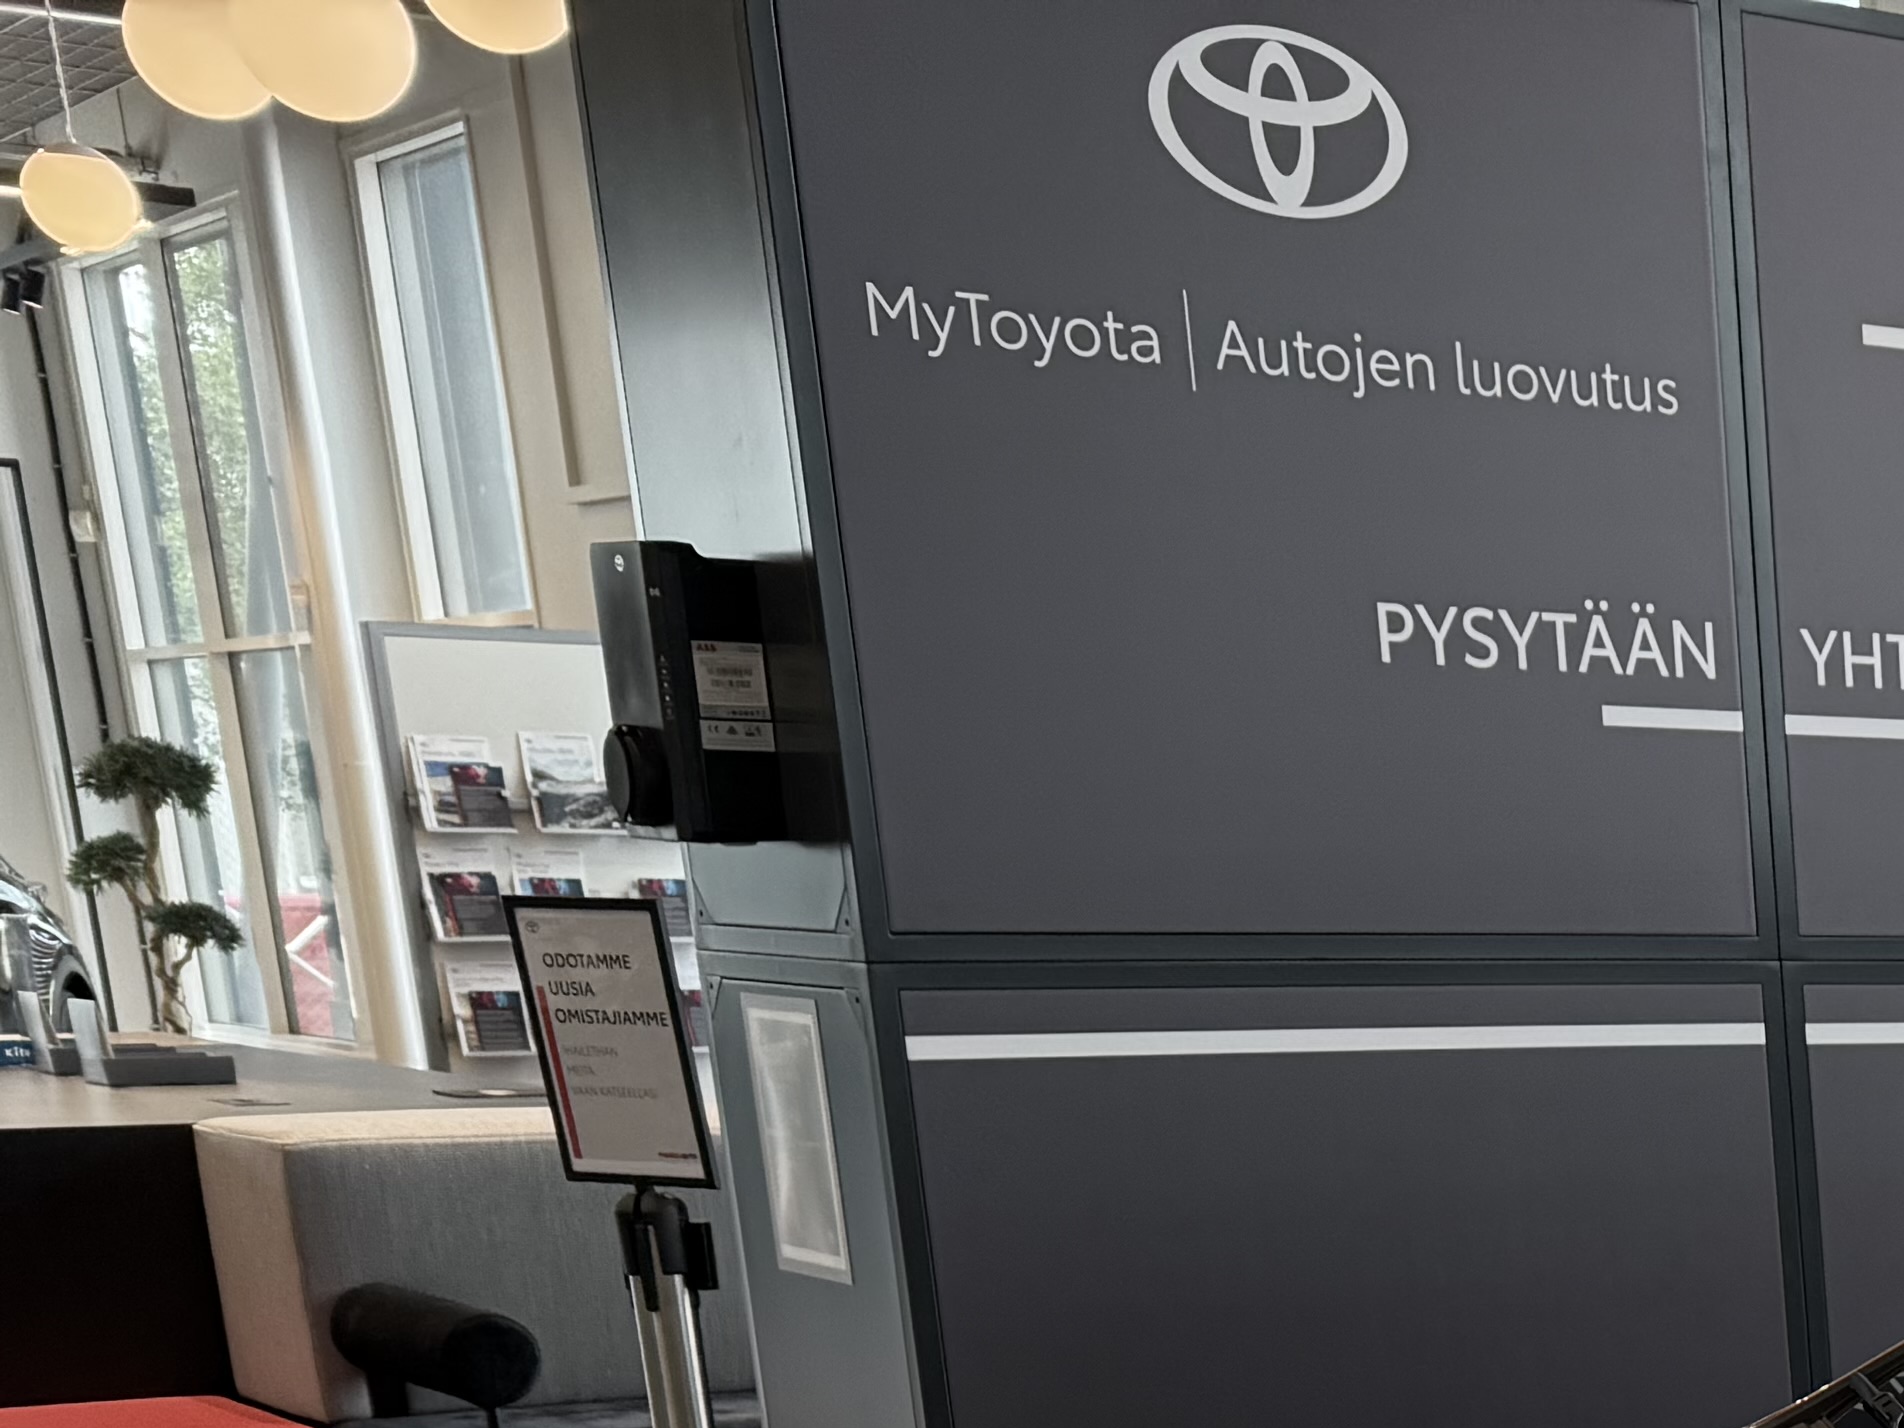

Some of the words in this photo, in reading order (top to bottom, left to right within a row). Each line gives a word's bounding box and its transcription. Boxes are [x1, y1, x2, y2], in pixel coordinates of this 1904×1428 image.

[864, 280, 1162, 368] MyToyota
[1215, 319, 1437, 400] Autojen
[1454, 341, 1681, 416] luovutus
[1376, 598, 1718, 681] PYSYTÄÄN
[542, 952, 632, 970] ODOTAMME
[548, 980, 596, 997] UUSIA
[554, 1007, 670, 1028] OMISTAJIAMME
